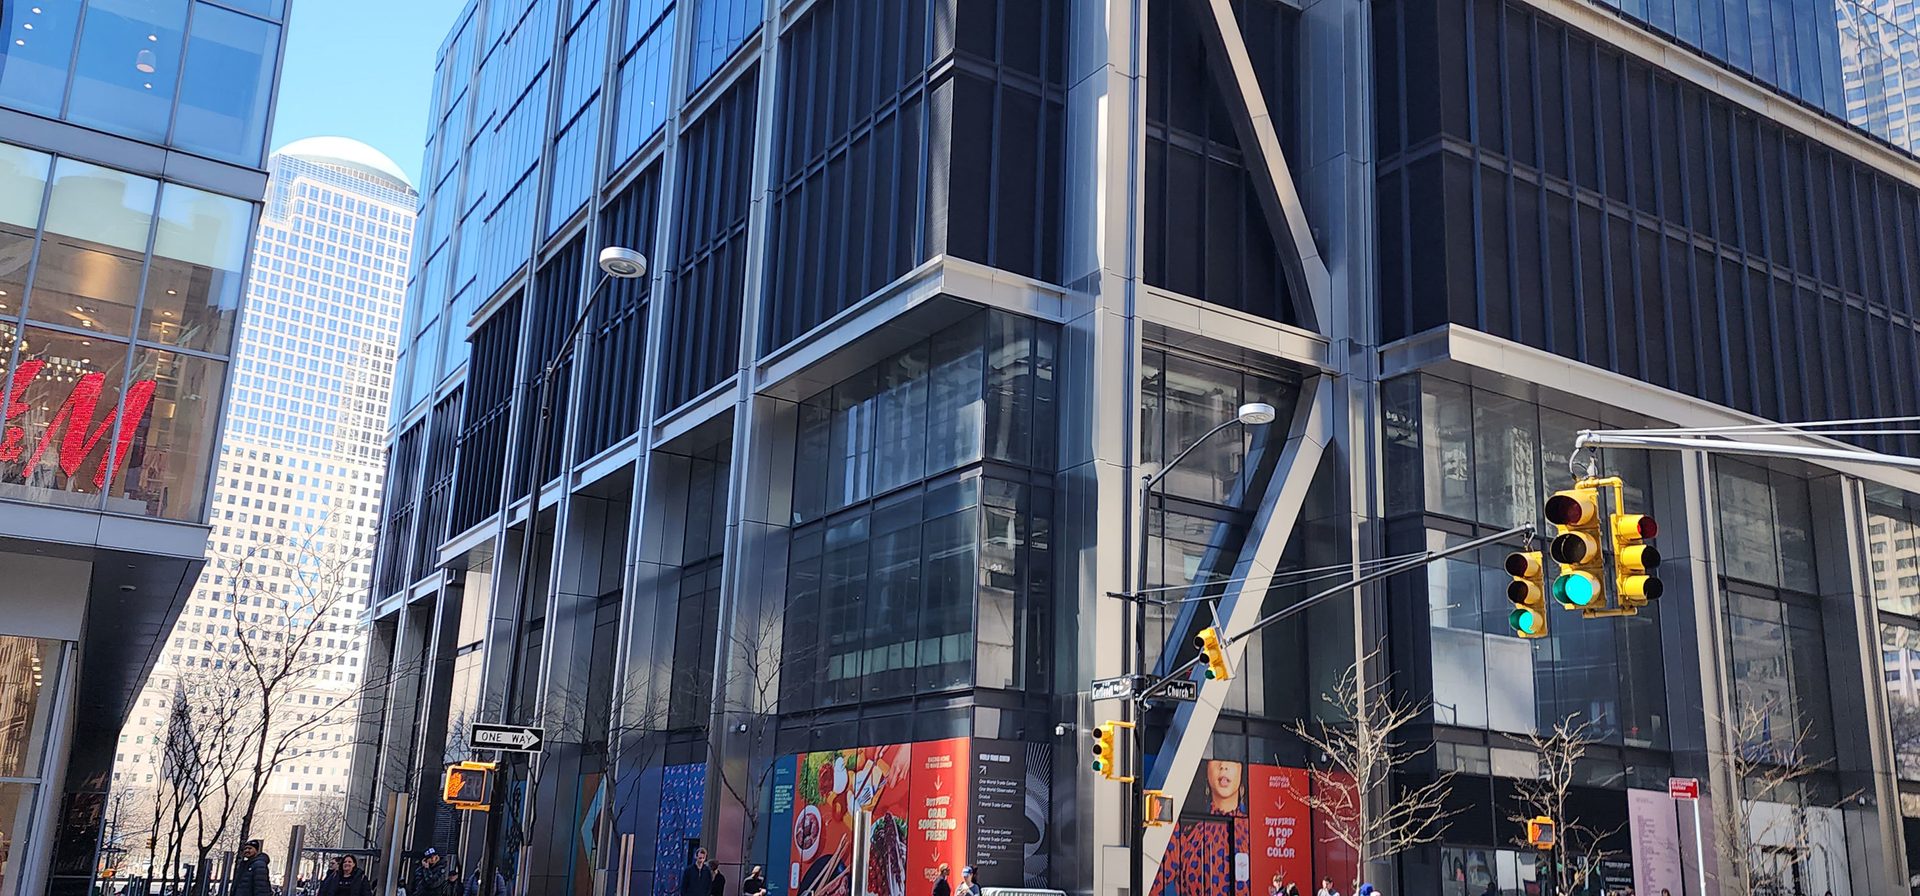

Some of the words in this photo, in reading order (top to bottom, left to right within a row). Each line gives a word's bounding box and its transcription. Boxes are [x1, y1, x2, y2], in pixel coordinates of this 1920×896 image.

[1168, 685, 1188, 698] Church
[481, 732, 502, 742] ONE
[512, 734, 532, 744] WAY
[928, 808, 947, 818] GRAB
[918, 818, 957, 830] SOMETHING
[926, 830, 948, 841] FRESH
[1268, 827, 1275, 837] A
[1276, 828, 1293, 838] POP
[1275, 838, 1286, 847] OF
[1267, 847, 1295, 858] COLOR
